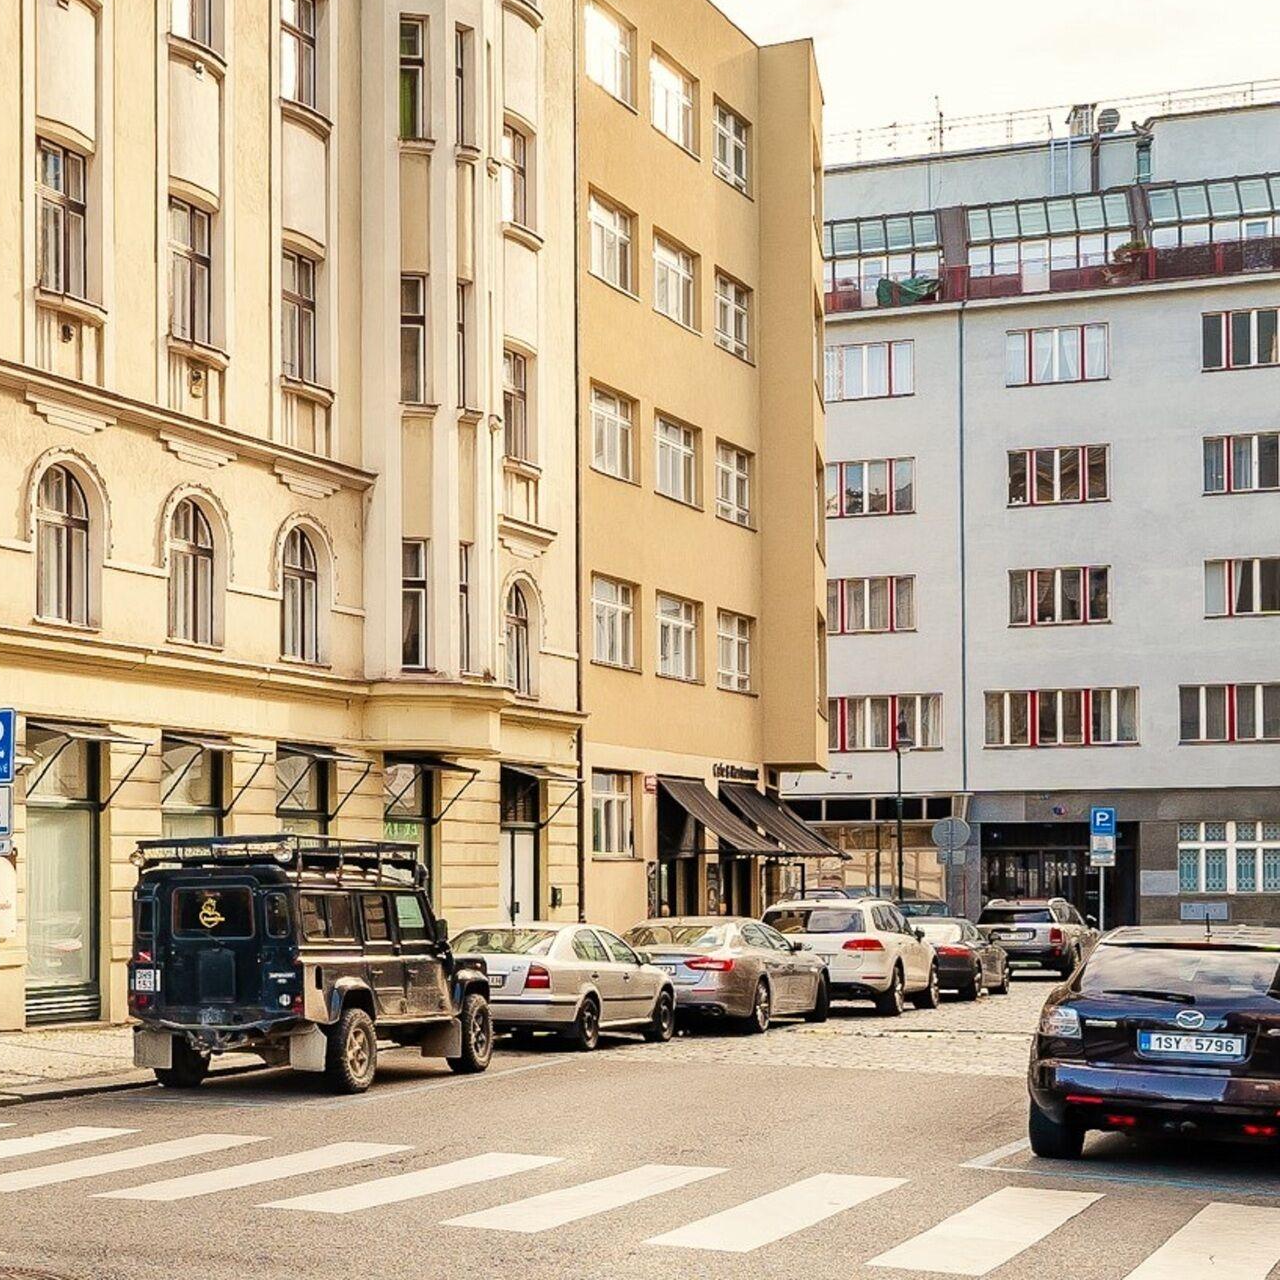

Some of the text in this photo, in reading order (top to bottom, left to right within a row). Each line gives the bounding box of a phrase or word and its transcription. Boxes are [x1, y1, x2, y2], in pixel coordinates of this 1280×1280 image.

[1096, 812, 1110, 827] P
[1154, 1036, 1235, 1053] 1SY 5796
